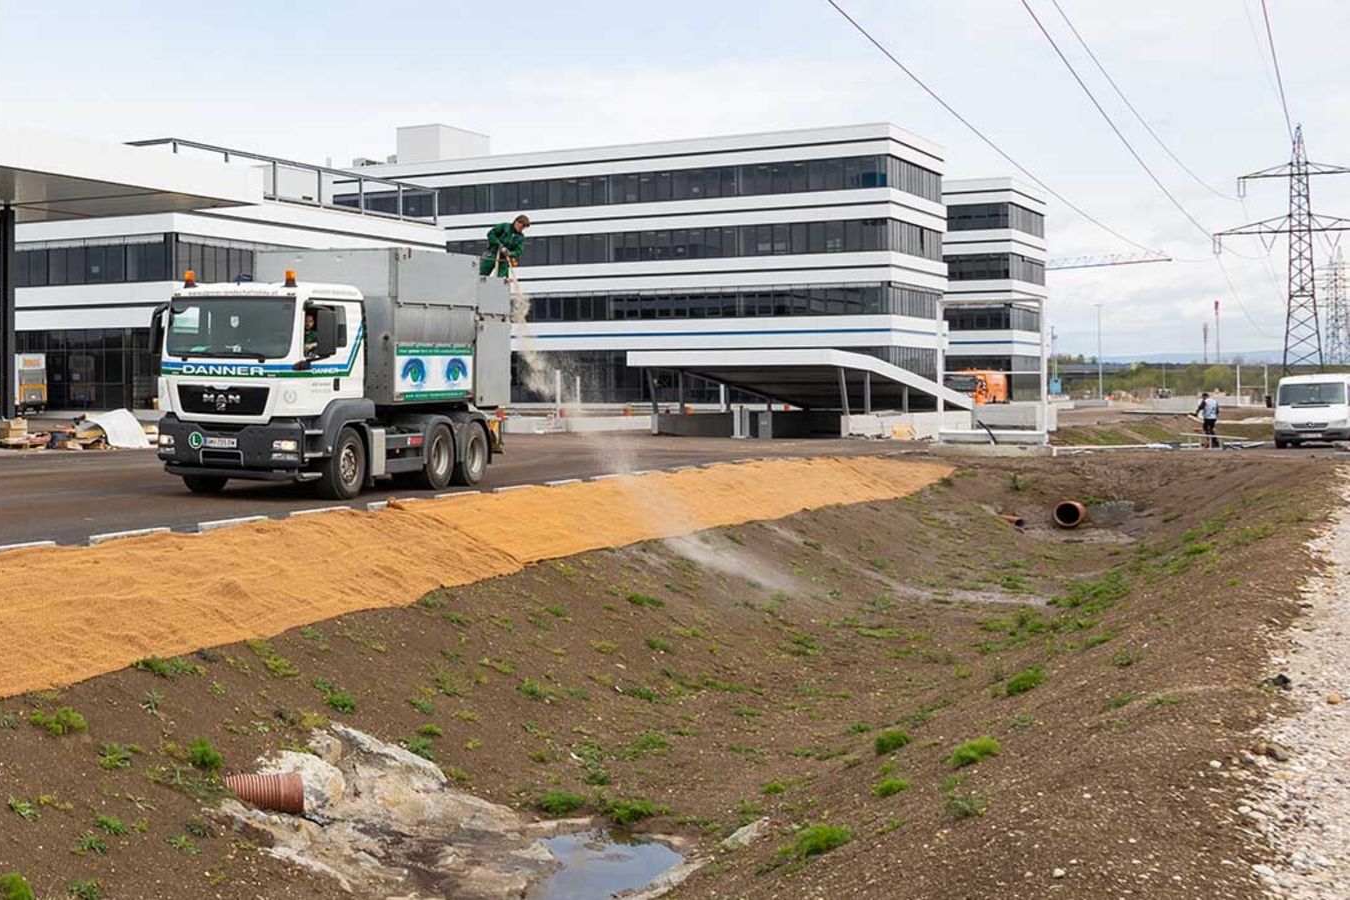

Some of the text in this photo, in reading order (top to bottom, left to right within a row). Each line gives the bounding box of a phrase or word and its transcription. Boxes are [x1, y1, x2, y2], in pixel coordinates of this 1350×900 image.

[182, 365, 265, 376] DANNER
[202, 393, 241, 403] MAN
[192, 435, 199, 446] L
